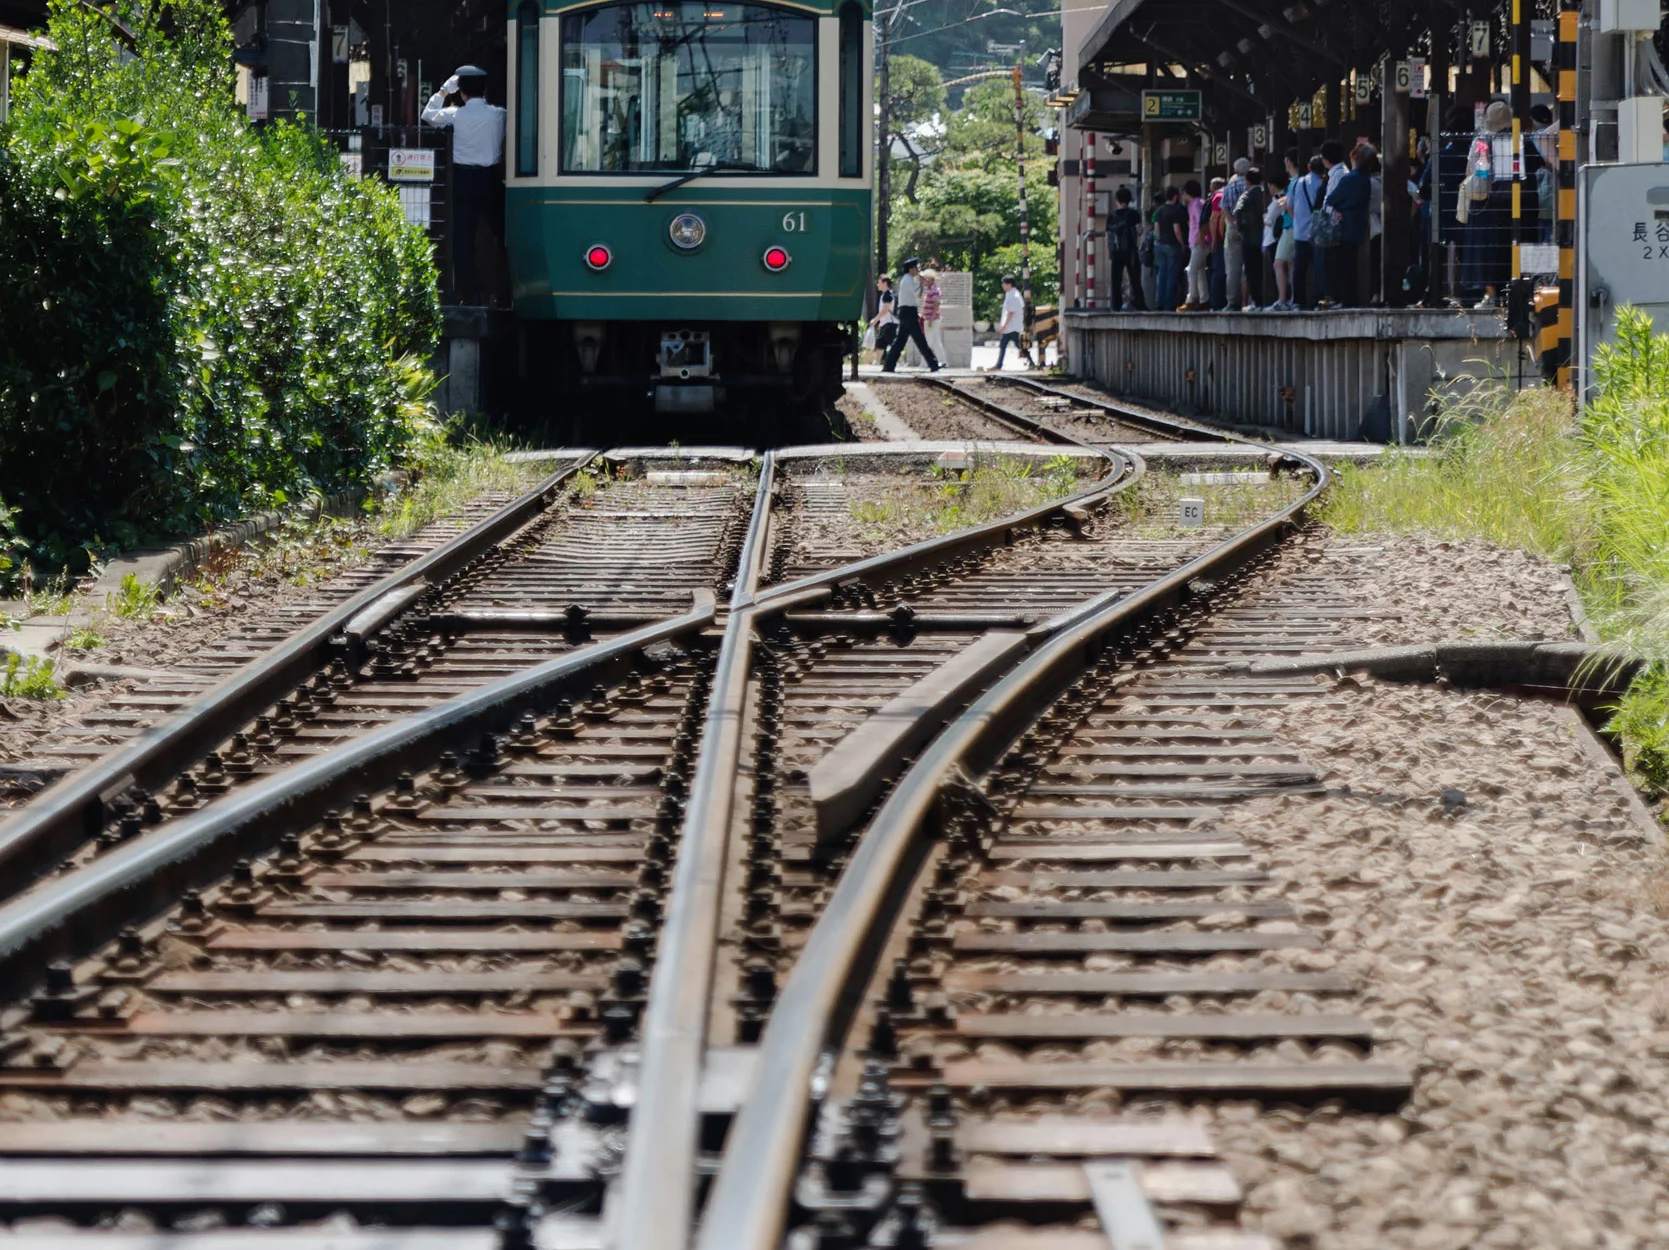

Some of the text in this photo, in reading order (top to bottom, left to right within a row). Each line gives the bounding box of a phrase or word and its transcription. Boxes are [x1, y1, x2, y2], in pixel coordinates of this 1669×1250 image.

[333, 32, 346, 56] 7
[1475, 28, 1487, 51] 7
[1398, 68, 1409, 88] 6
[1357, 79, 1368, 99] 5
[1147, 98, 1156, 112] 2
[1300, 107, 1310, 122] 4
[1255, 128, 1264, 144] 3
[1217, 146, 1226, 161] 2
[782, 211, 806, 232] 61
[1632, 222, 1669, 242] 長谷
[1184, 506, 1198, 518] EC
